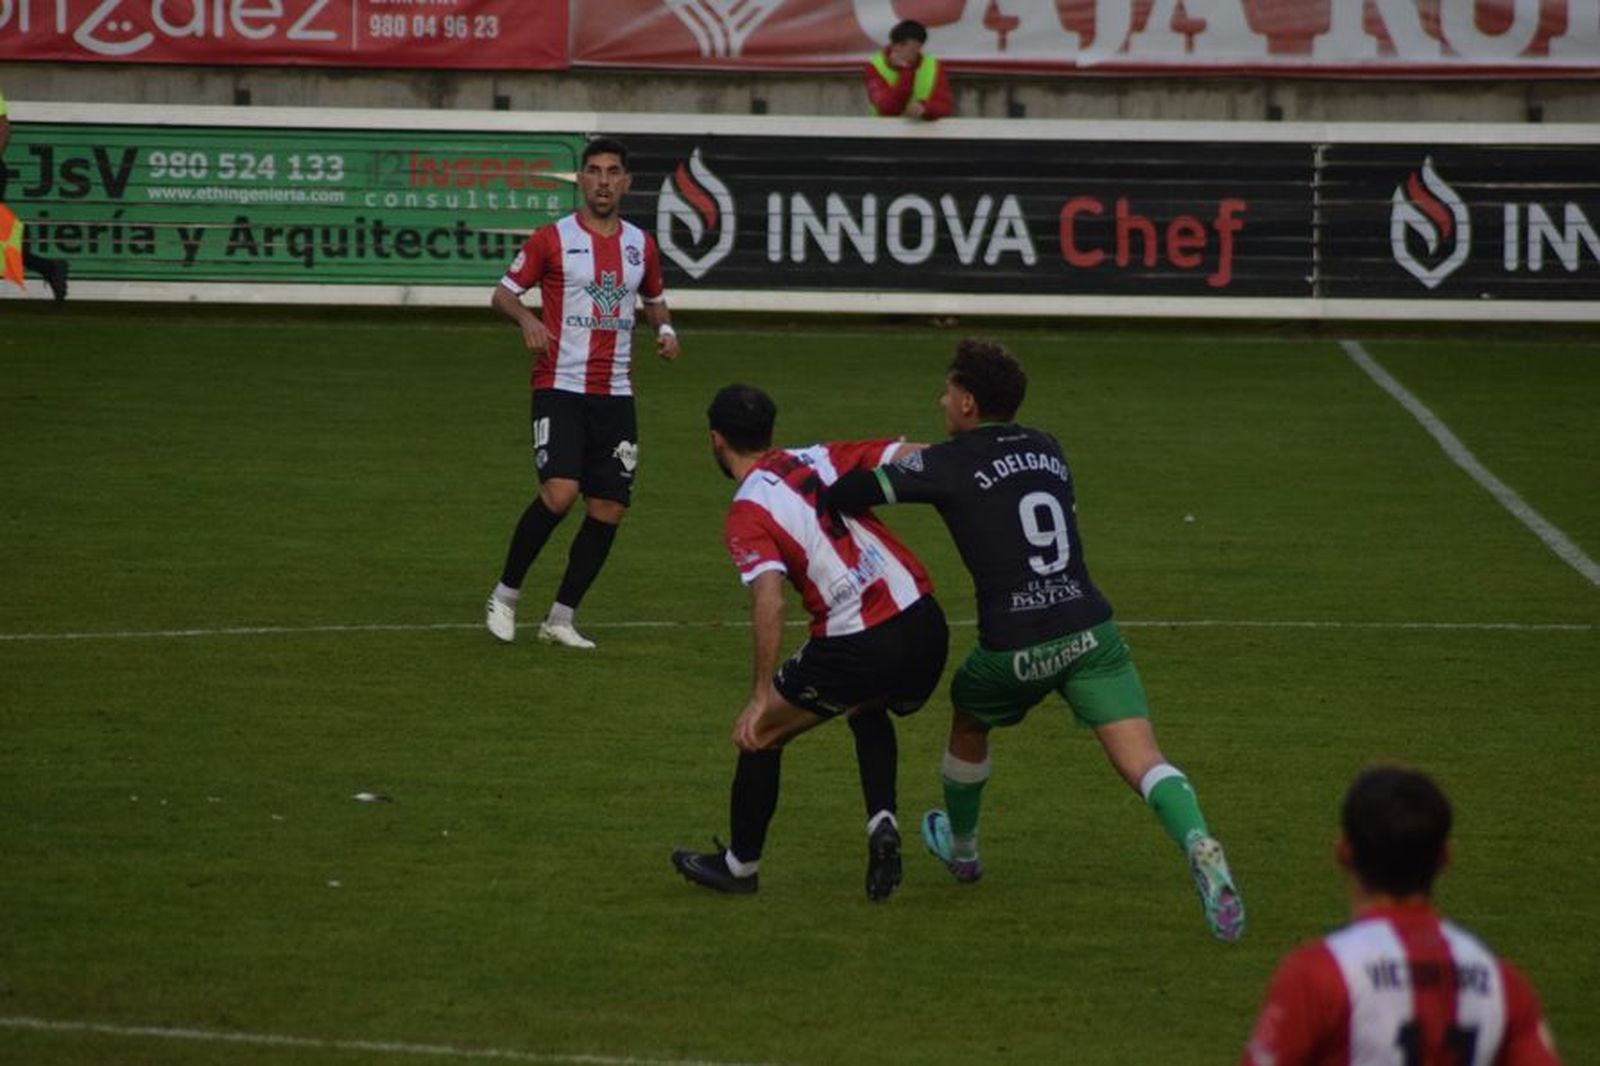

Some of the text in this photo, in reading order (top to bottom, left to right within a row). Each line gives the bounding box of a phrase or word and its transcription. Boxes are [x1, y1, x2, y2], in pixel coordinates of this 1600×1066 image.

[370, 14, 498, 38] 980 04 96 23
[149, 151, 207, 179] 980
[218, 154, 276, 180] 524
[287, 154, 345, 181] 133
[365, 191, 559, 214] consulting
[177, 227, 205, 266] y
[767, 193, 1246, 287] INNOVA Chef
[1018, 491, 1070, 575] 9
